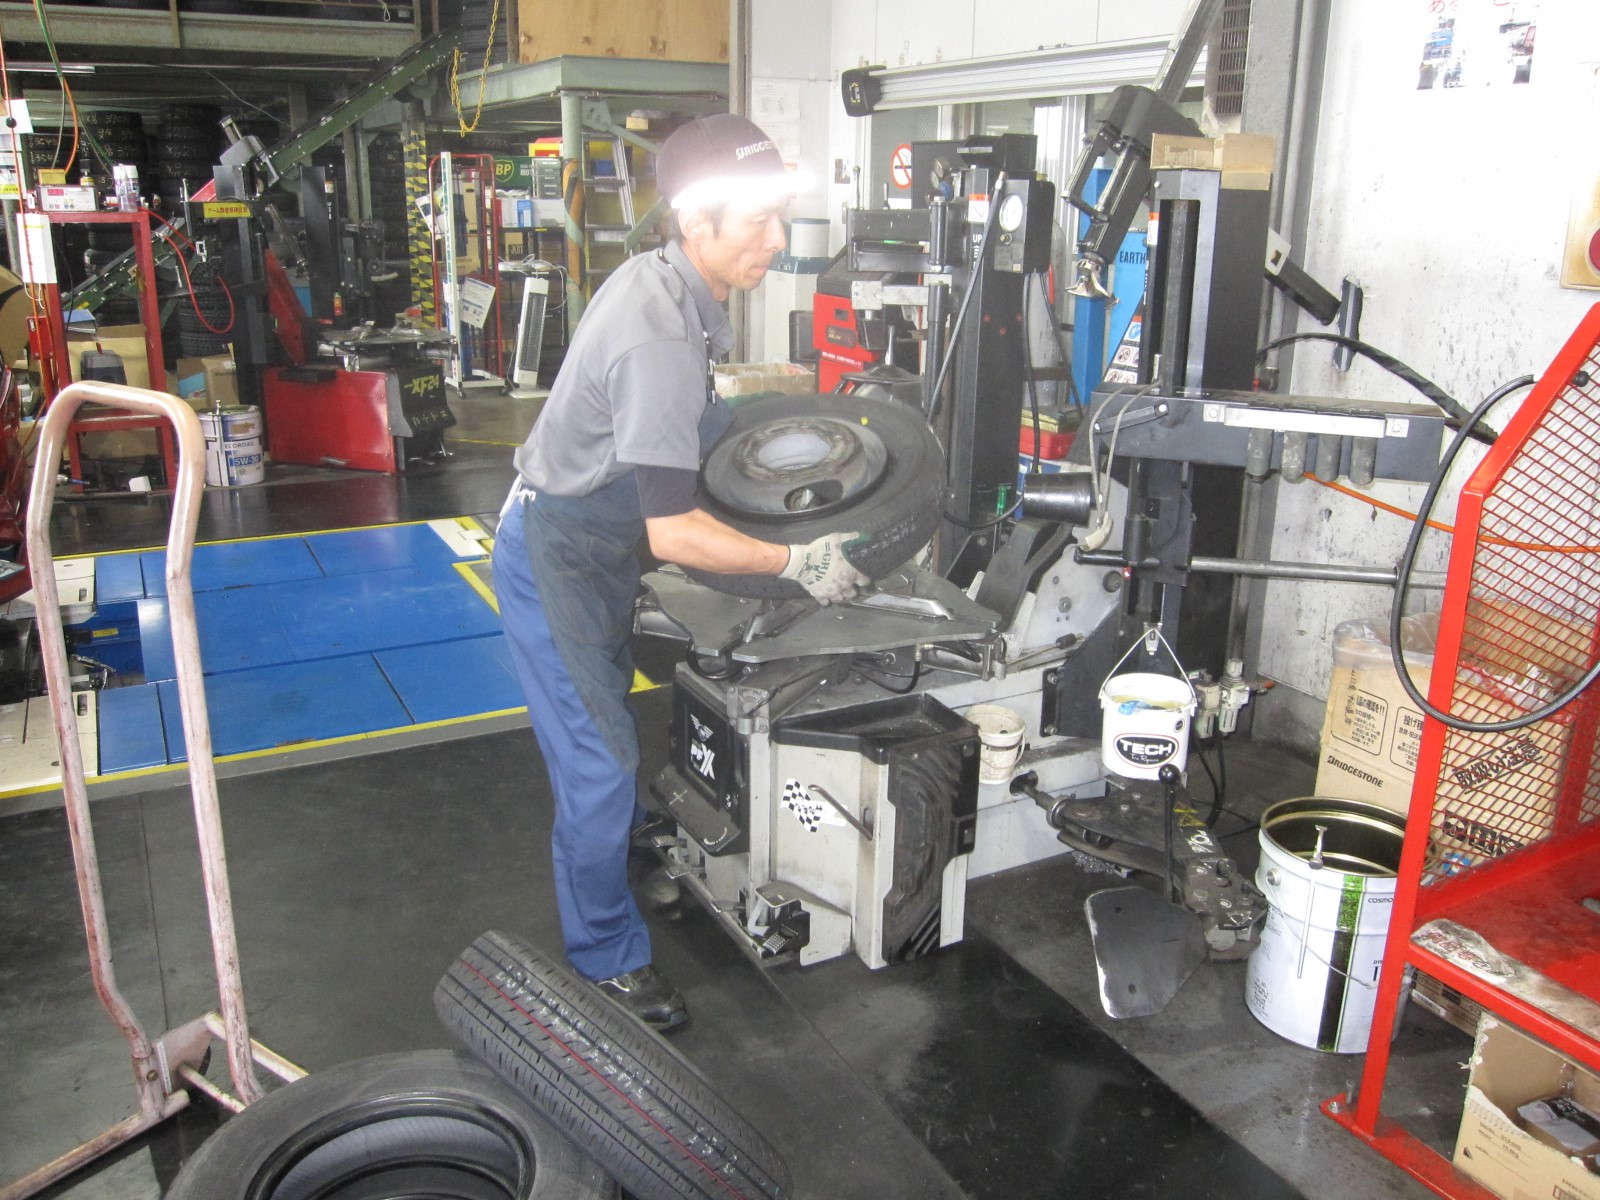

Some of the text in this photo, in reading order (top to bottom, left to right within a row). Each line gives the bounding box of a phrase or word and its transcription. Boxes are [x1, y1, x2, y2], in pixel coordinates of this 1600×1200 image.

[495, 163, 512, 175] BP
[972, 234, 983, 243] UP
[1119, 250, 1147, 265] EARTH
[234, 455, 260, 466] 5W-30
[1120, 739, 1172, 756] TECH
[1327, 755, 1384, 788] BRIDGESTONE
